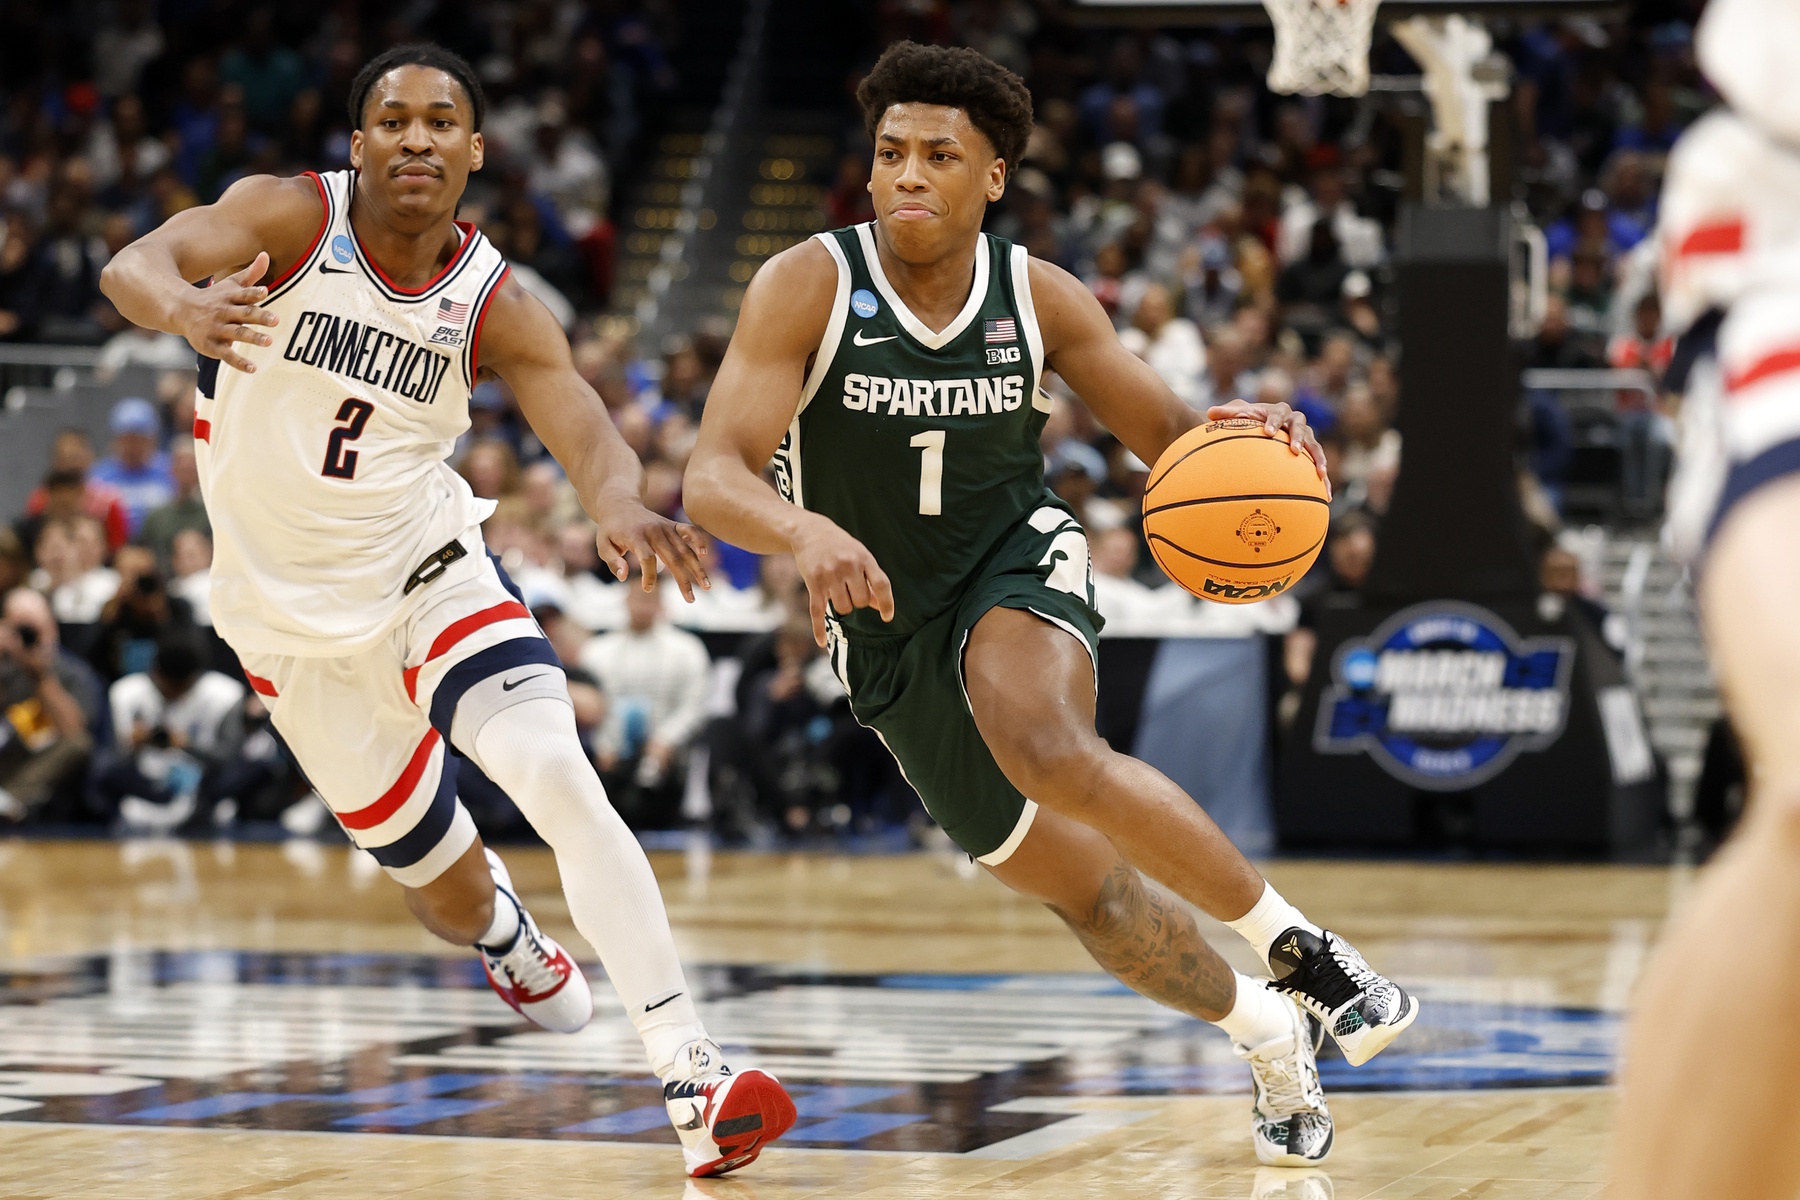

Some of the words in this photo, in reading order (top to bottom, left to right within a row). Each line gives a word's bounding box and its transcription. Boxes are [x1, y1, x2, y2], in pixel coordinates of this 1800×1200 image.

[854, 301, 877, 315] NCAA
[431, 333, 466, 346] EAST
[435, 326, 462, 337] BIG
[283, 311, 451, 405] CONNECTICUT
[842, 373, 1025, 416] SPARTANS
[321, 397, 375, 480] 2
[909, 430, 946, 516] 1
[1203, 578, 1292, 599] NCAA
